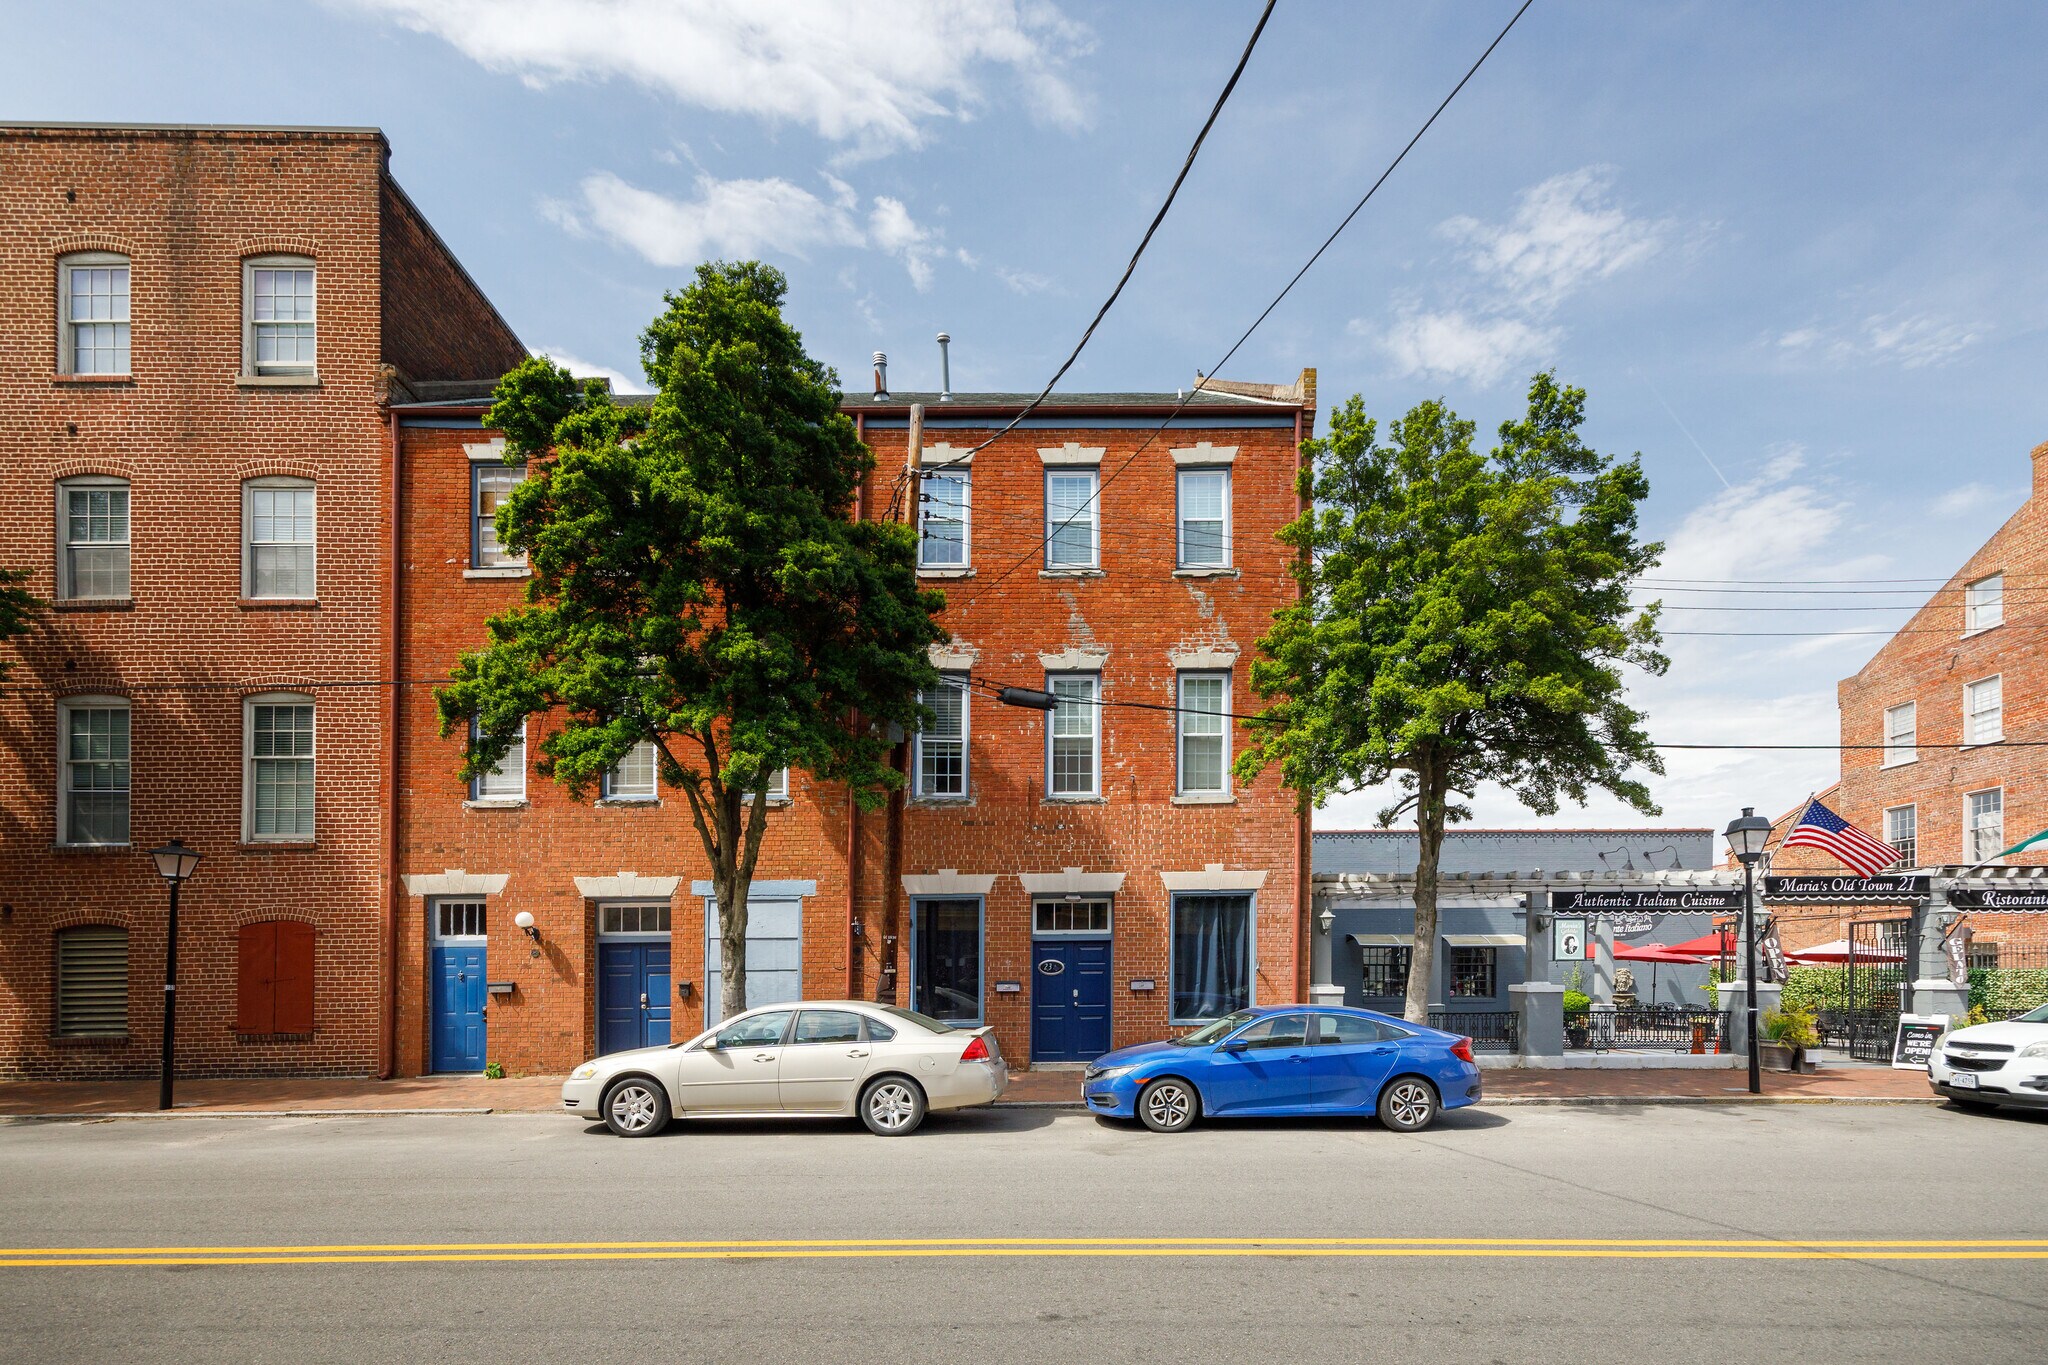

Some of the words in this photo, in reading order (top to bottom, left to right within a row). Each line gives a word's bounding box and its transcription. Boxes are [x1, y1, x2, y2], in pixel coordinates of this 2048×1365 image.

[1779, 878, 1828, 892] Maria's
[1831, 877, 1858, 892] Old
[1858, 878, 1894, 892] Town
[1897, 876, 1916, 892] 21
[1569, 893, 1632, 909] Authentic
[1634, 892, 1677, 907] Italian
[1681, 892, 1726, 908] Cuisine
[1764, 937, 1786, 979] OPEN
[1948, 937, 1964, 984] GELATO
[1906, 1031, 1924, 1039] Come
[1907, 1039, 1932, 1047] WE'RE
